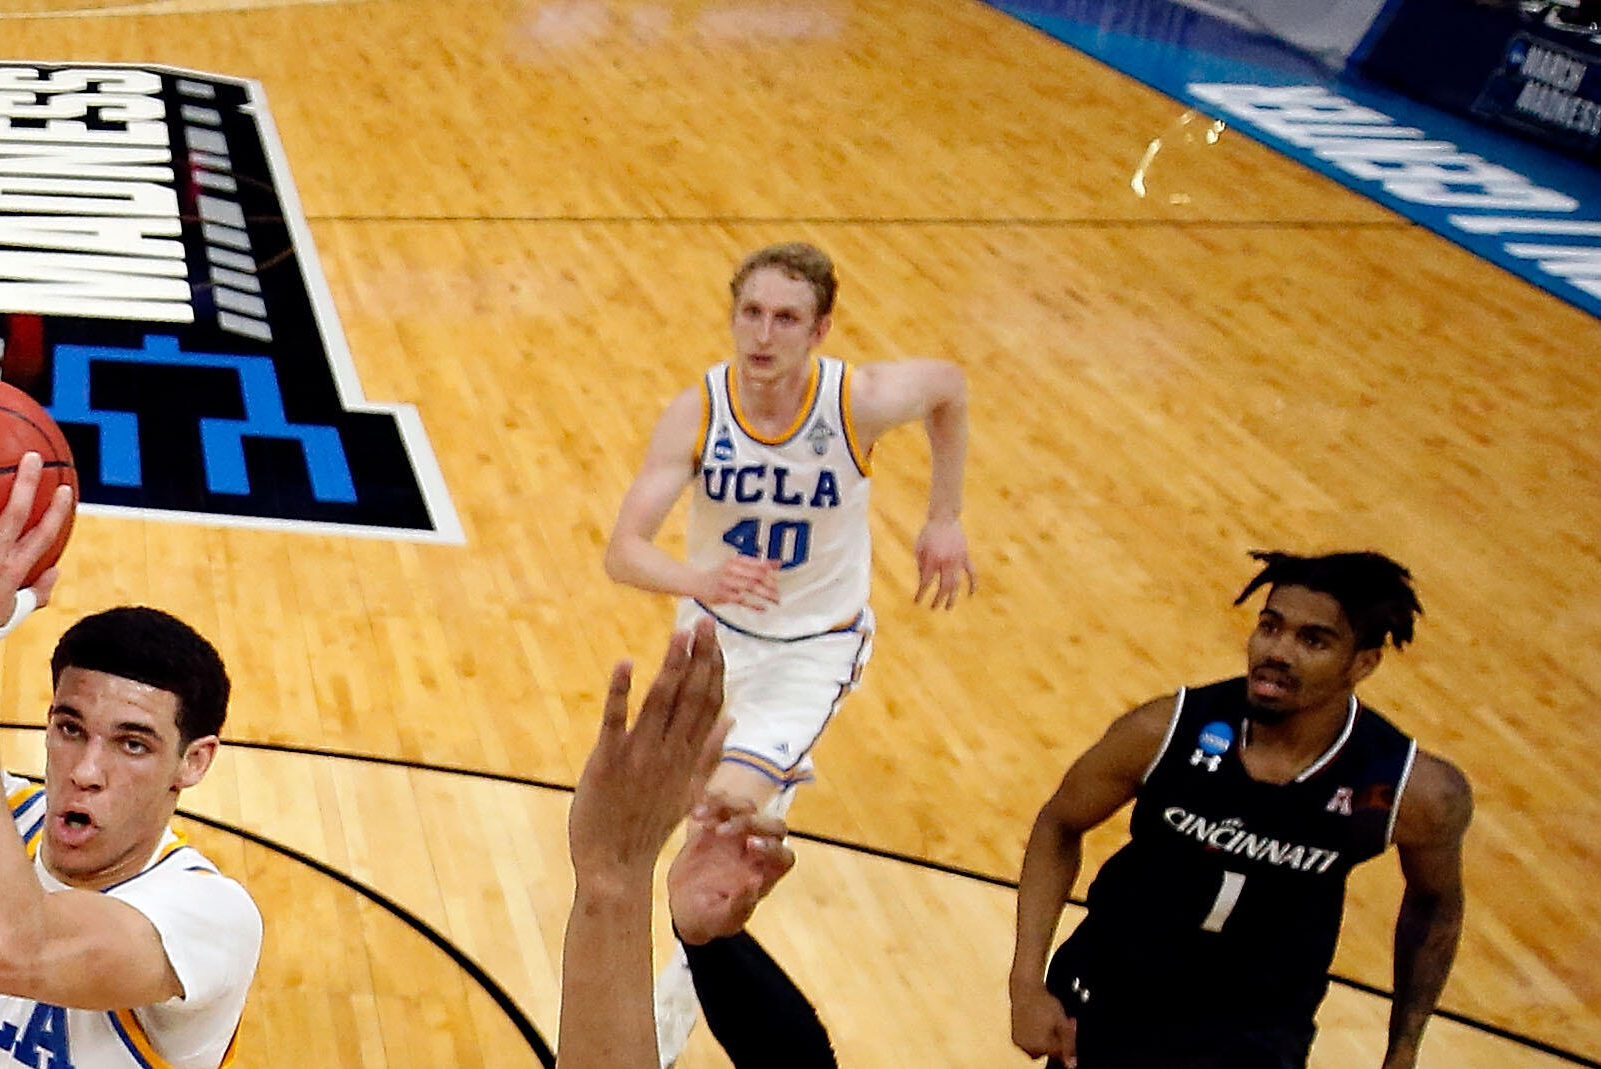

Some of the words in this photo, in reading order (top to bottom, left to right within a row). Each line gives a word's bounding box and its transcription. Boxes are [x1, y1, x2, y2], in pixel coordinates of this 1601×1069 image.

[704, 464, 841, 508] UCLA
[723, 517, 811, 571] 40
[1163, 806, 1340, 873] CINCINNATI
[1200, 870, 1247, 933] 1
